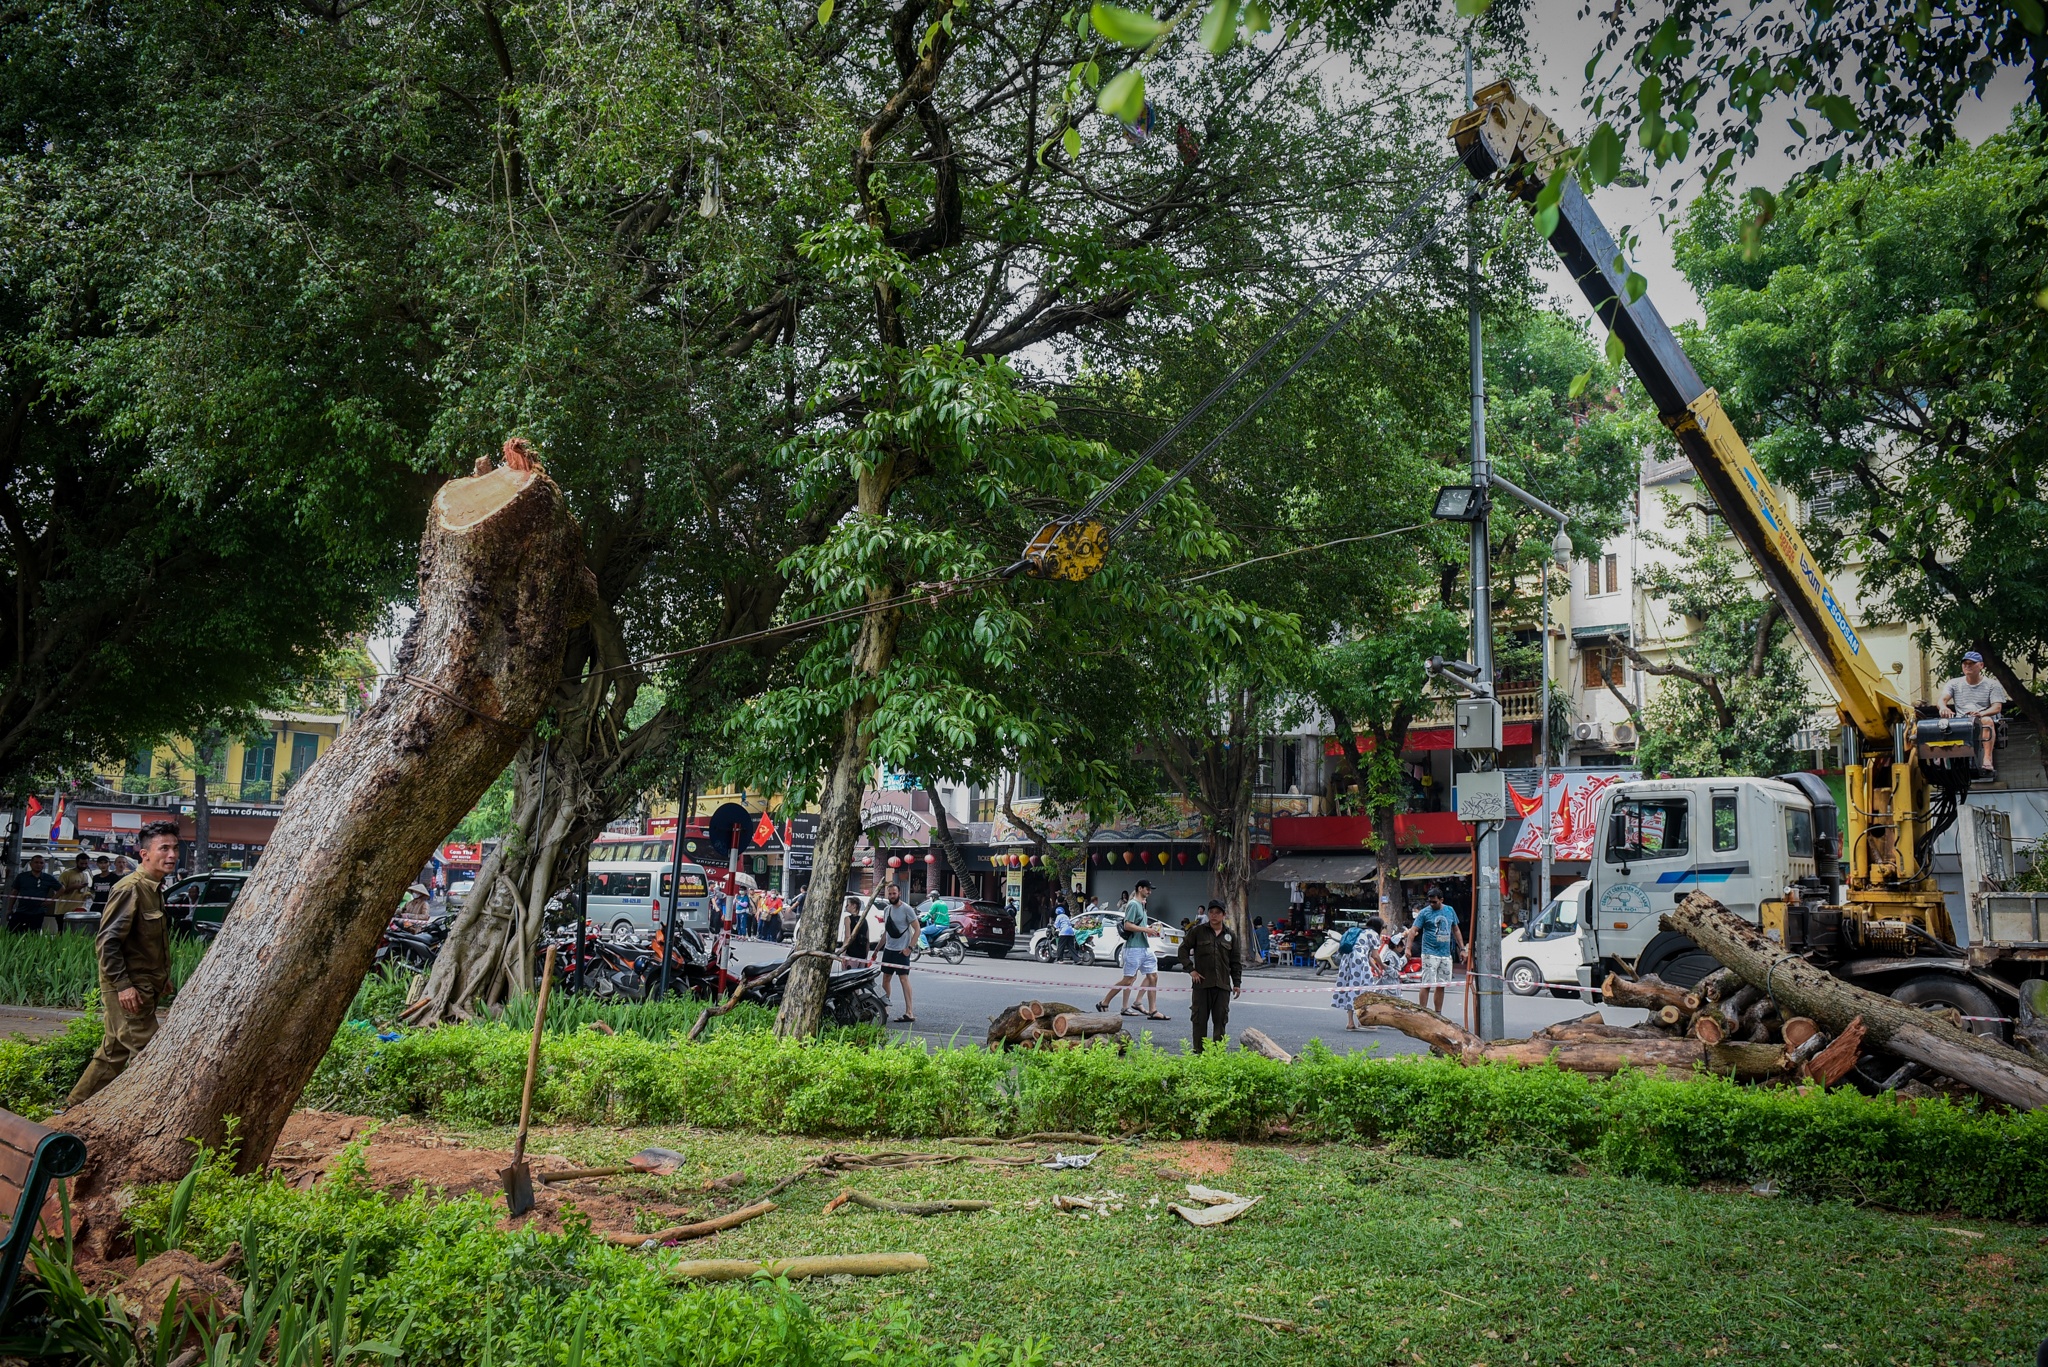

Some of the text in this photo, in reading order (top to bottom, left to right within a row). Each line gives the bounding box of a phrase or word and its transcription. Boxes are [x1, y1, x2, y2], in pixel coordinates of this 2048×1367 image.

[1759, 489, 1775, 513] SCS
[1773, 514, 1798, 551] 1015LS
[1830, 604, 1859, 652] SOOSAN
[907, 814, 921, 832] LONG
[231, 843, 245, 851] 53
